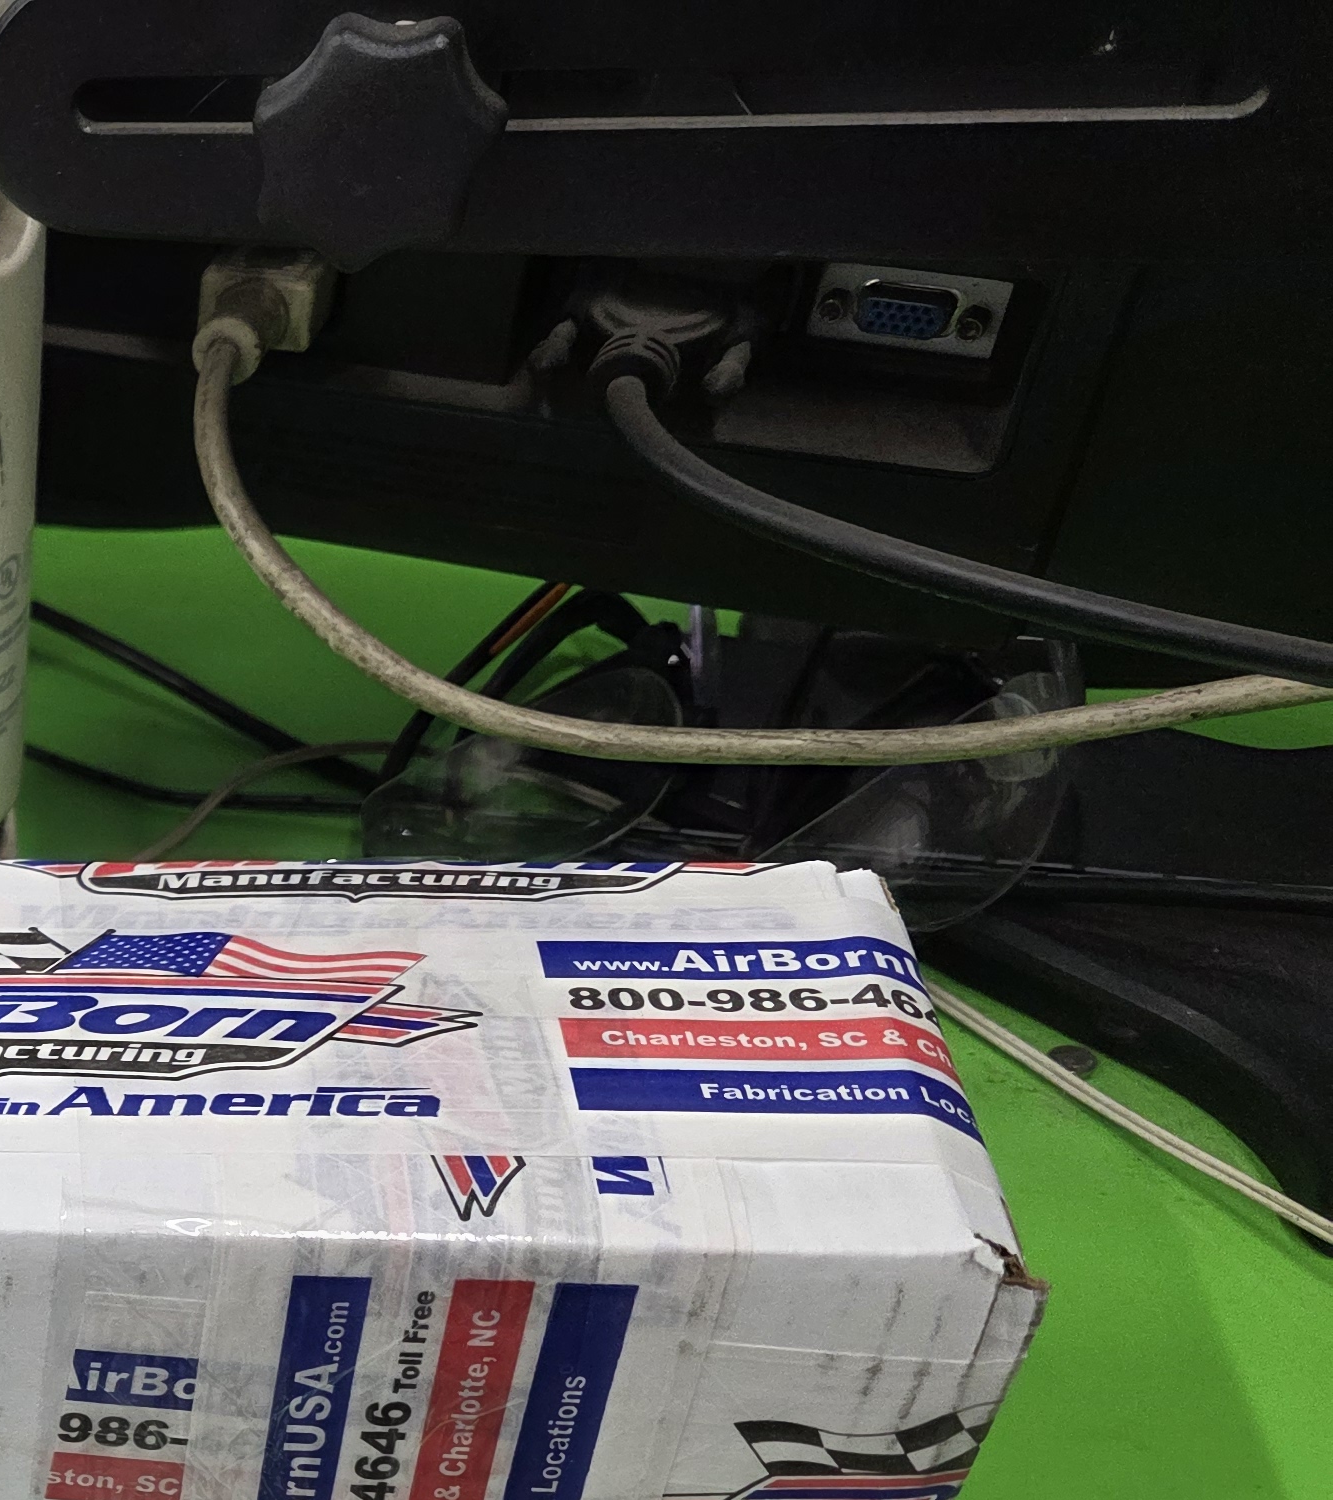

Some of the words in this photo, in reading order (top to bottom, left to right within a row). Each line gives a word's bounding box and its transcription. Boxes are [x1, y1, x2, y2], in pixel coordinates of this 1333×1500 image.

[158, 869, 562, 890] Manufacturing
[600, 1029, 808, 1052] Charleston,
[817, 1030, 869, 1048] SC
[881, 1028, 908, 1047] &
[46, 1085, 442, 1118] America
[699, 1082, 910, 1102] Fabrication
[403, 1289, 436, 1346] Free
[467, 1308, 501, 1348] NC
[391, 1351, 423, 1394] Toll
[57, 1411, 189, 1451] 986-
[438, 1357, 498, 1480] Charlotte,
[533, 1372, 588, 1494] Locations
[135, 1474, 180, 1496] SC
